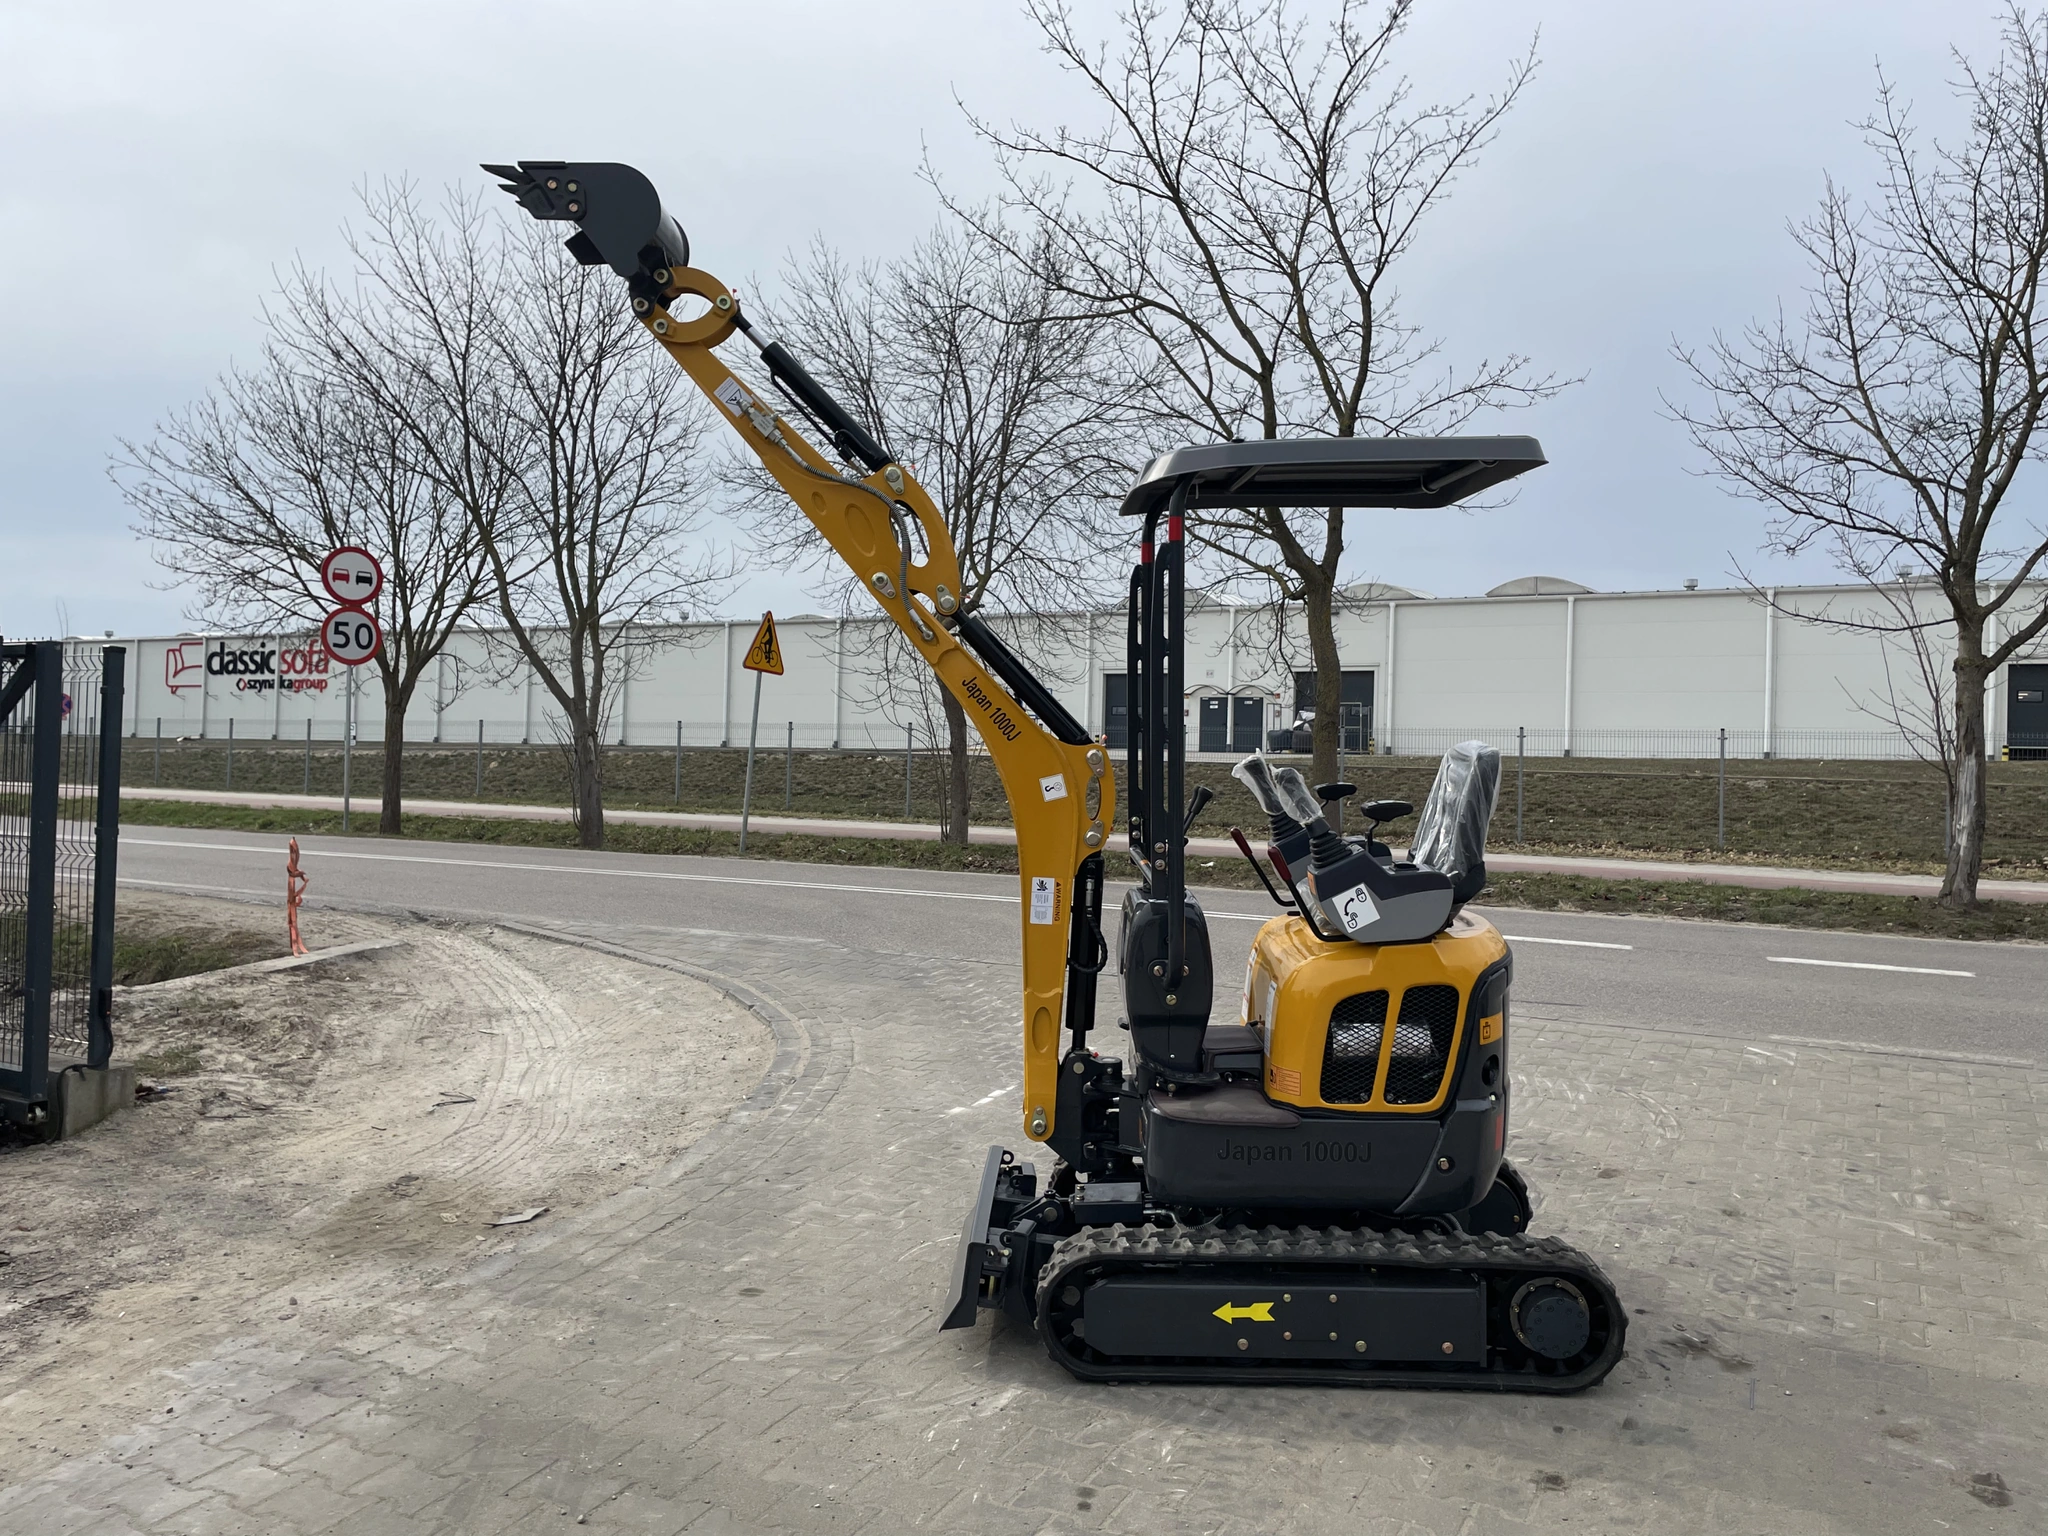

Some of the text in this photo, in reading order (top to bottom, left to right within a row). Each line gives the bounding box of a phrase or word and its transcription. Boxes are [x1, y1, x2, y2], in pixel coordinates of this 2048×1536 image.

[332, 621, 374, 650] 50
[206, 638, 329, 675] classic sofa
[961, 676, 1022, 742] Japan 1000J
[1054, 888, 1062, 922] WARNING
[1216, 1138, 1373, 1166] Japan 1000J
